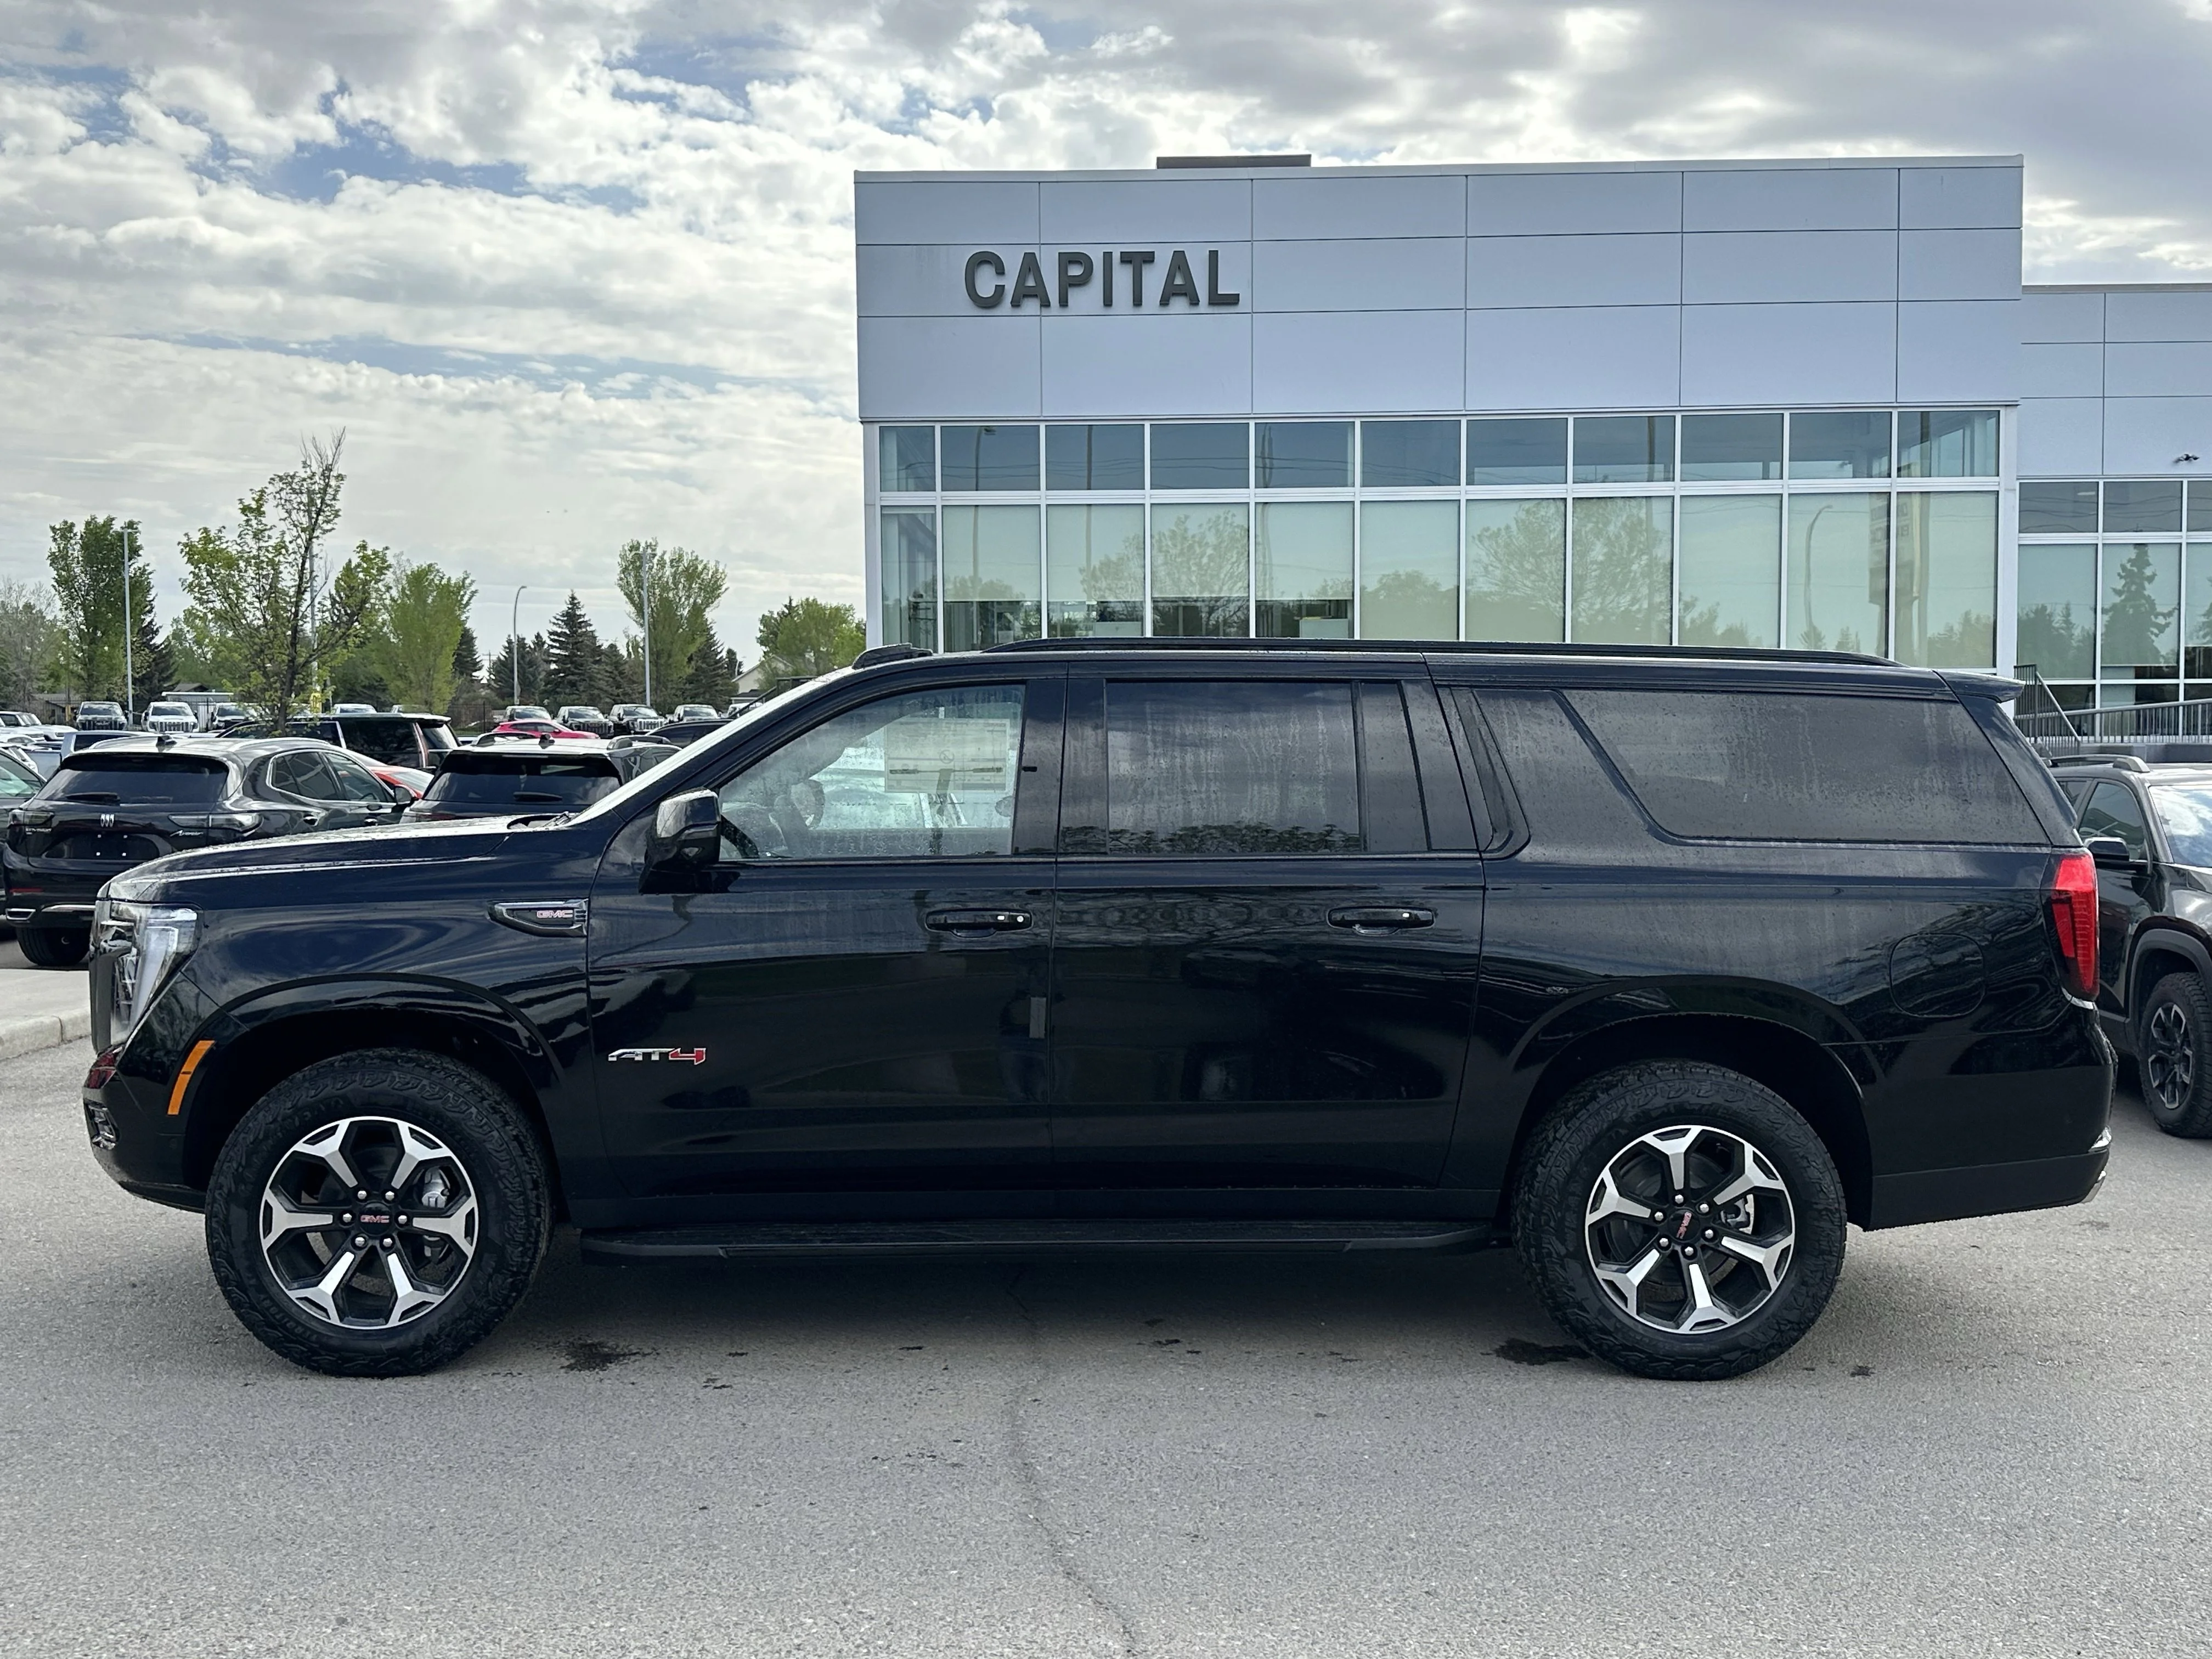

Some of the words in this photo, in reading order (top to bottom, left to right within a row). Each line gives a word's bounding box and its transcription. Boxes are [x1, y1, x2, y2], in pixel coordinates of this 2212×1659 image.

[964, 250, 1240, 308] CAPITAL
[537, 910, 573, 918] GMC
[608, 1047, 707, 1065] AT4
[360, 1214, 390, 1223] GMC
[1676, 1211, 1692, 1239] GMC
